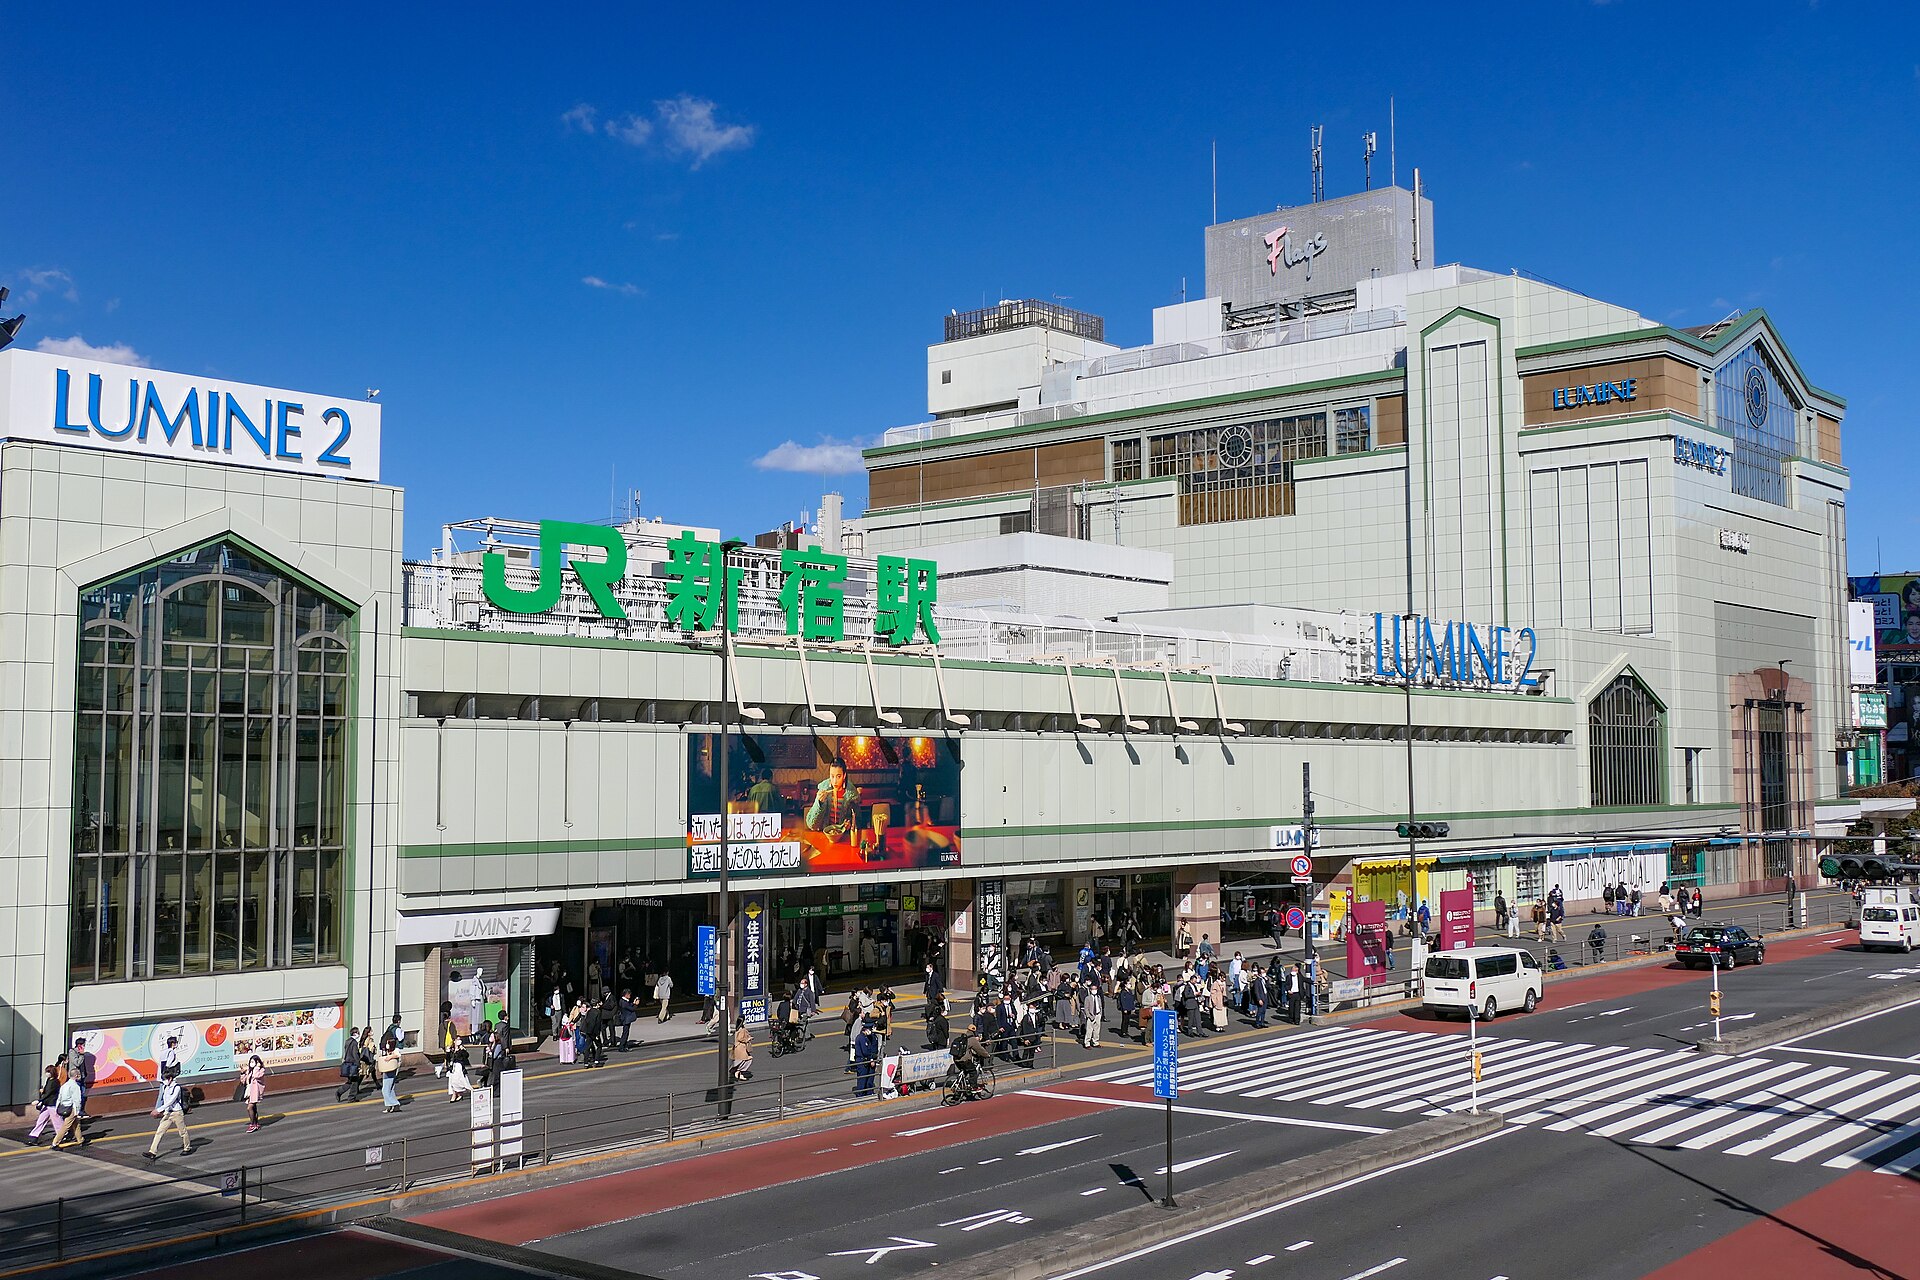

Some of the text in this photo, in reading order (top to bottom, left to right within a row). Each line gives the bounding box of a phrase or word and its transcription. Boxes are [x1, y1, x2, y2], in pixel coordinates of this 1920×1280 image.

[1263, 226, 1328, 280] Flags
[1553, 378, 1637, 411] LUMINE
[54, 368, 351, 465] LUMINE 2
[482, 520, 941, 645] JR 新宿駅
[1874, 617, 1895, 625] ロミス
[1375, 612, 1537, 686] LUMINE 2
[454, 915, 532, 938] LUMINE 2
[747, 920, 760, 990] 住友不動産
[752, 999, 765, 1007] No.1
[266, 1056, 297, 1065] RESTAURANT
[297, 1054, 314, 1062] FLOOR
[1155, 1056, 1163, 1095] 入れません
